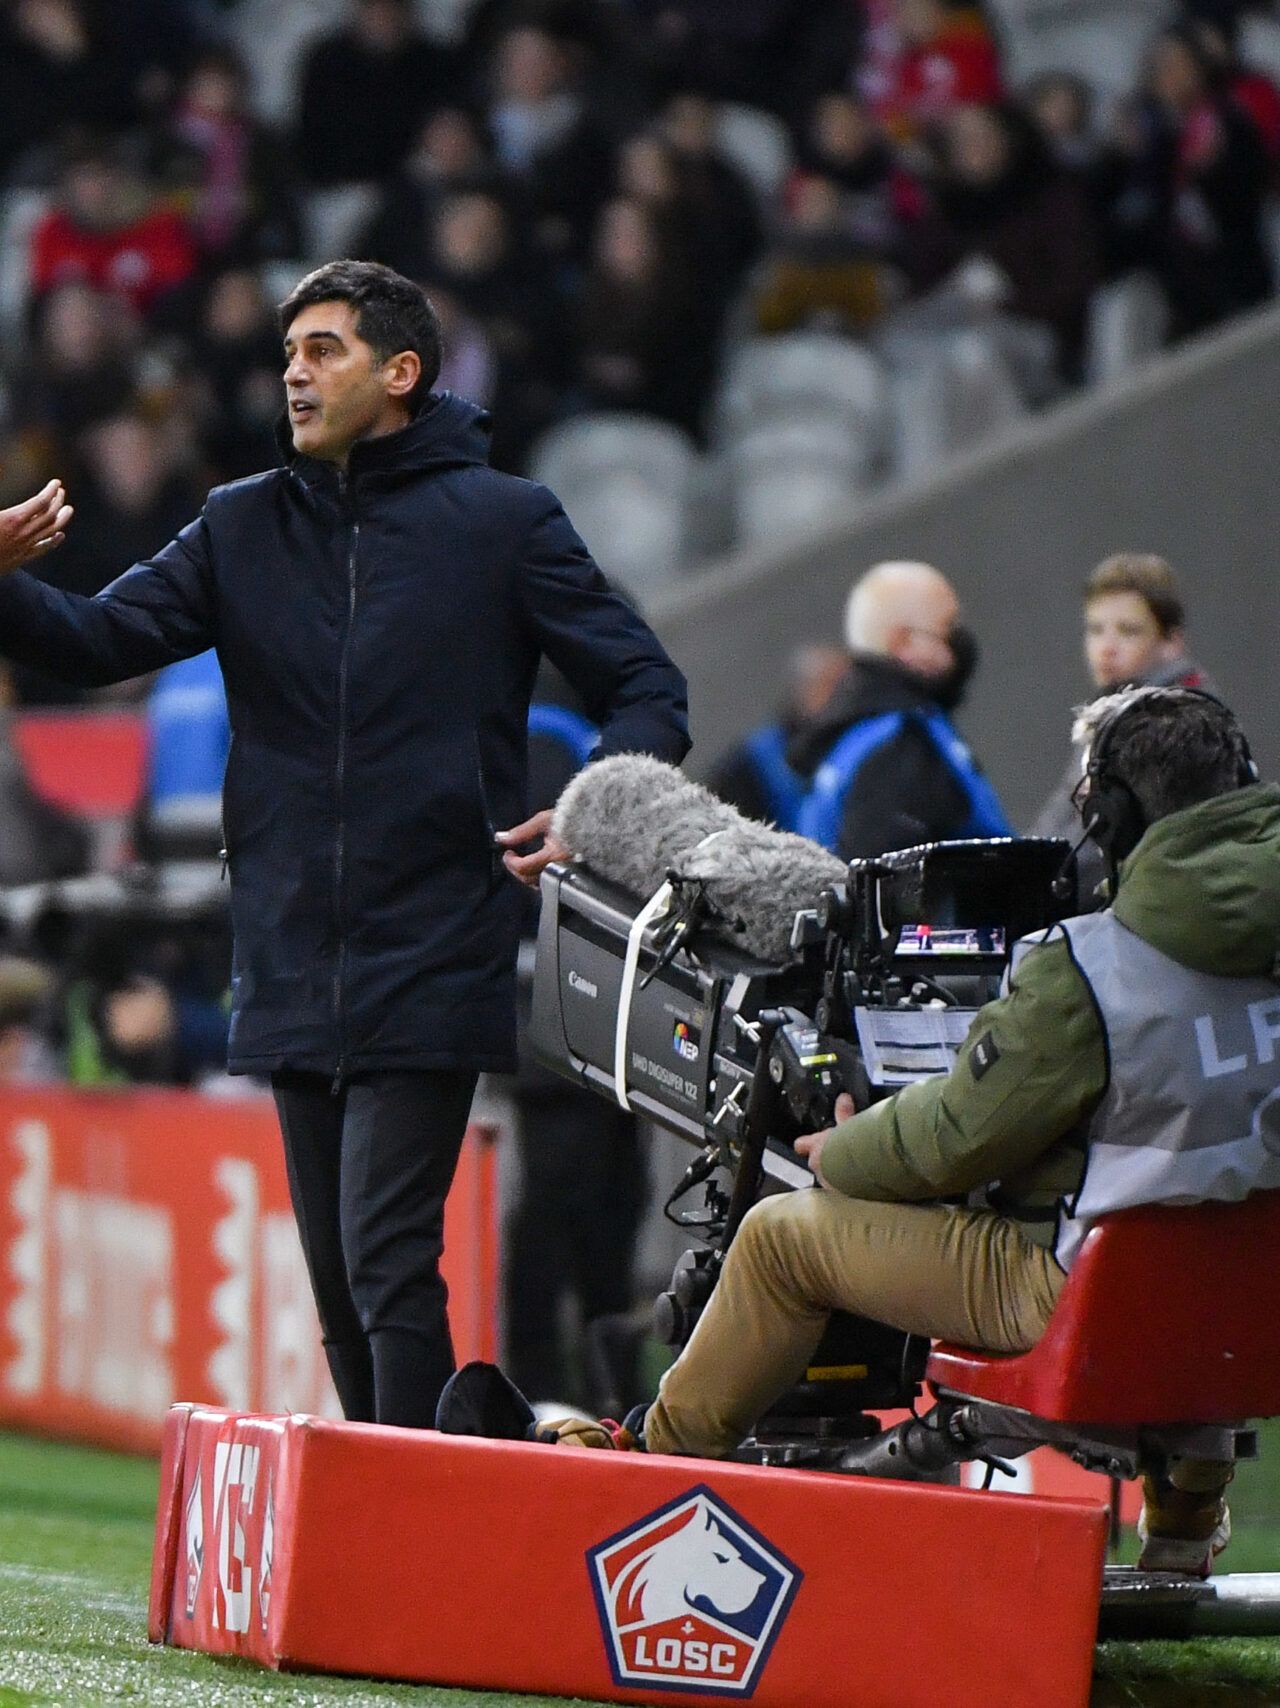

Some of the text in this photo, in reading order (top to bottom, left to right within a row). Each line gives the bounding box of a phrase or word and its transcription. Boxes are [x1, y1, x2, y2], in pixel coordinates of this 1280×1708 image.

[568, 970, 598, 998] Canon
[679, 1038, 699, 1062] NEP
[684, 1079, 698, 1100] 122
[634, 1635, 737, 1675] LOSC
